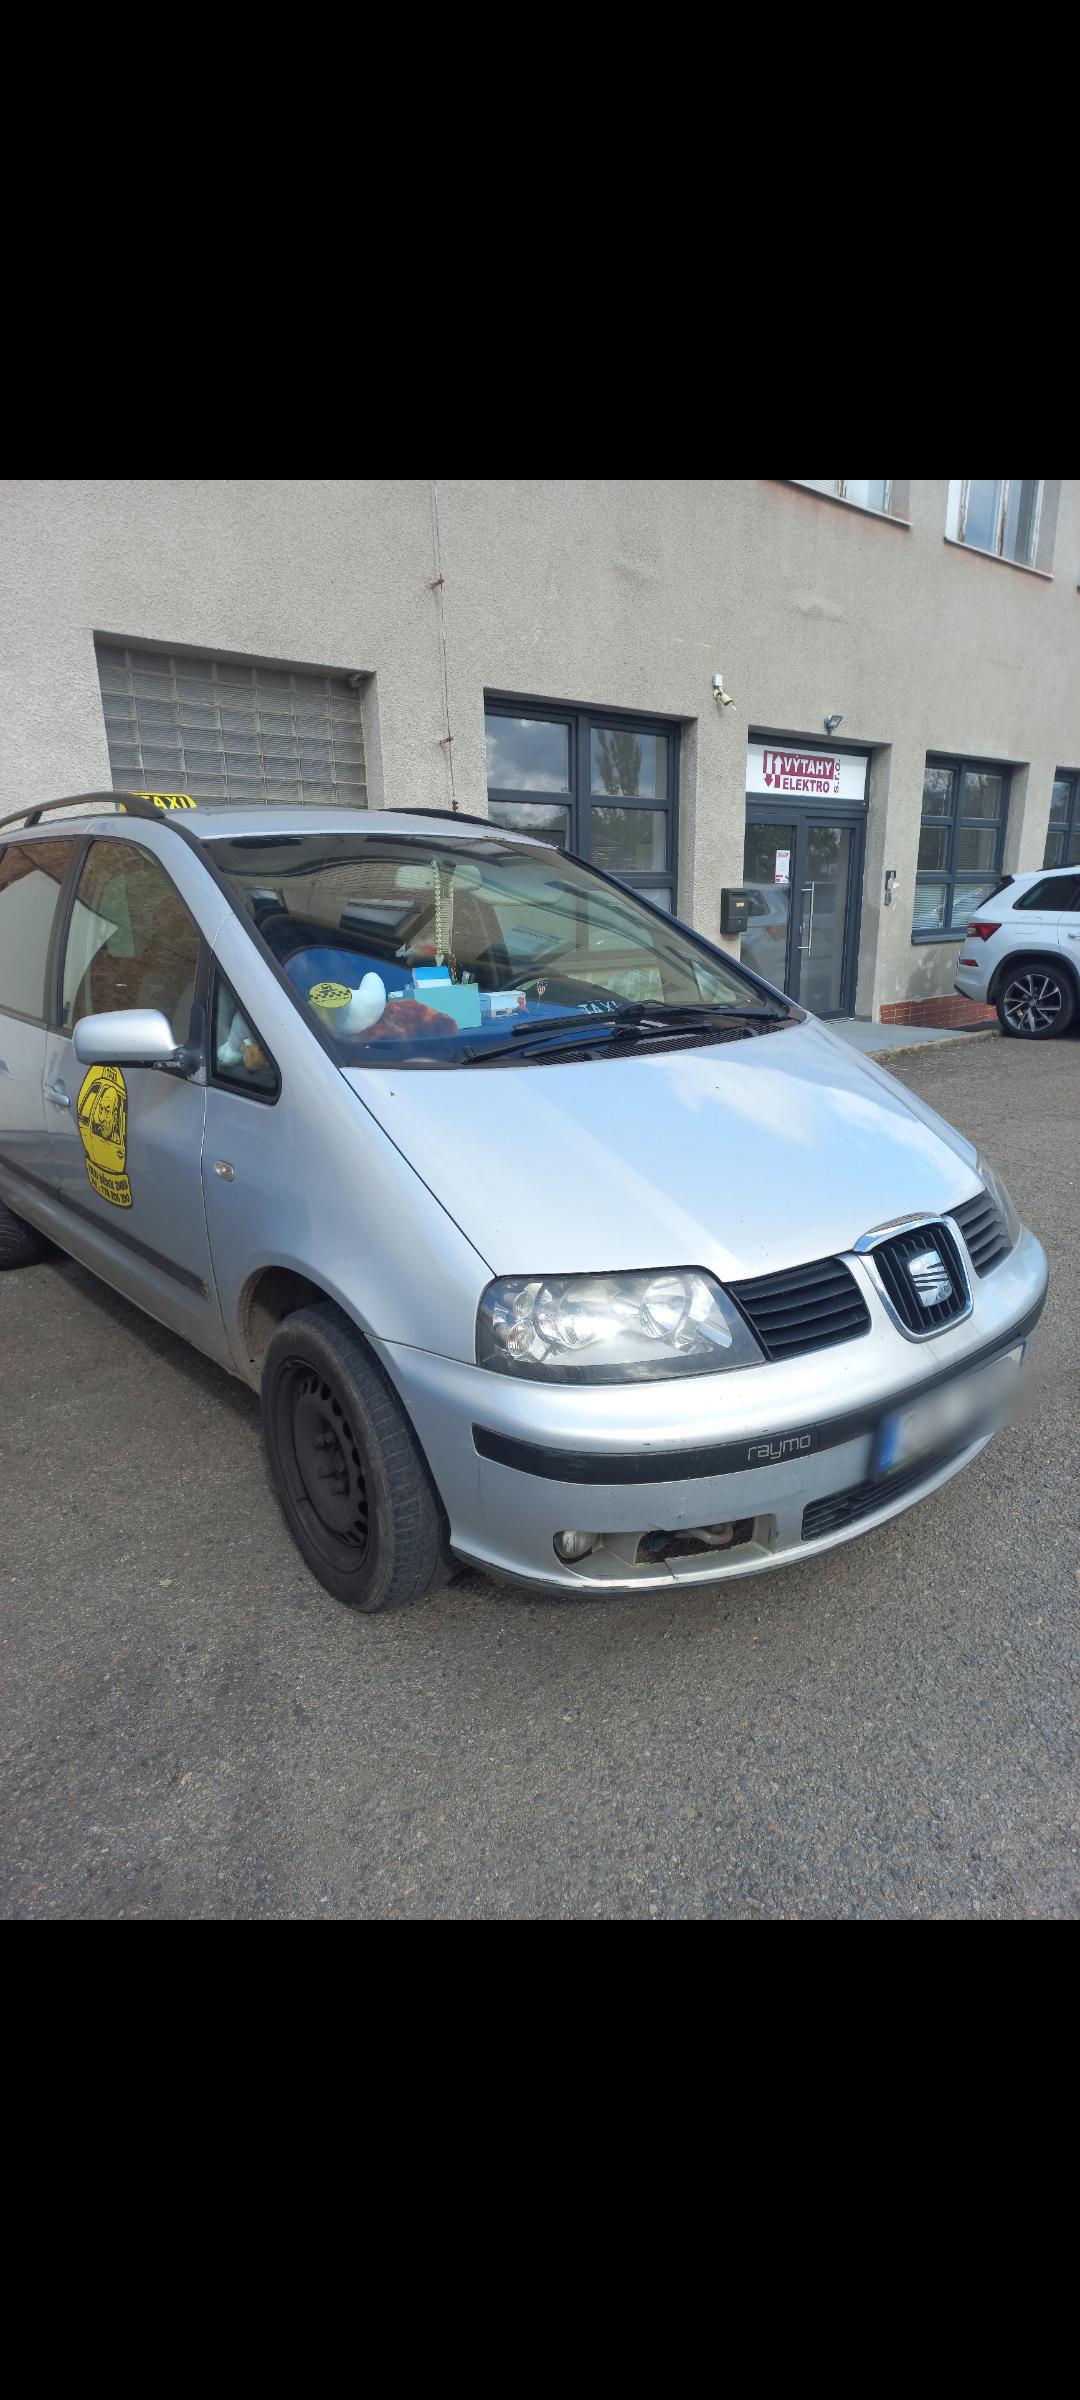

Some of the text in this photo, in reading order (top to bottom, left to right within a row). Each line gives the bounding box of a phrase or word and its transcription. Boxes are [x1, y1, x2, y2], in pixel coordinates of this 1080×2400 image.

[783, 755, 833, 777] VÝTAHY
[783, 777, 830, 794] ELEKTRO
[140, 795, 188, 810] AXI
